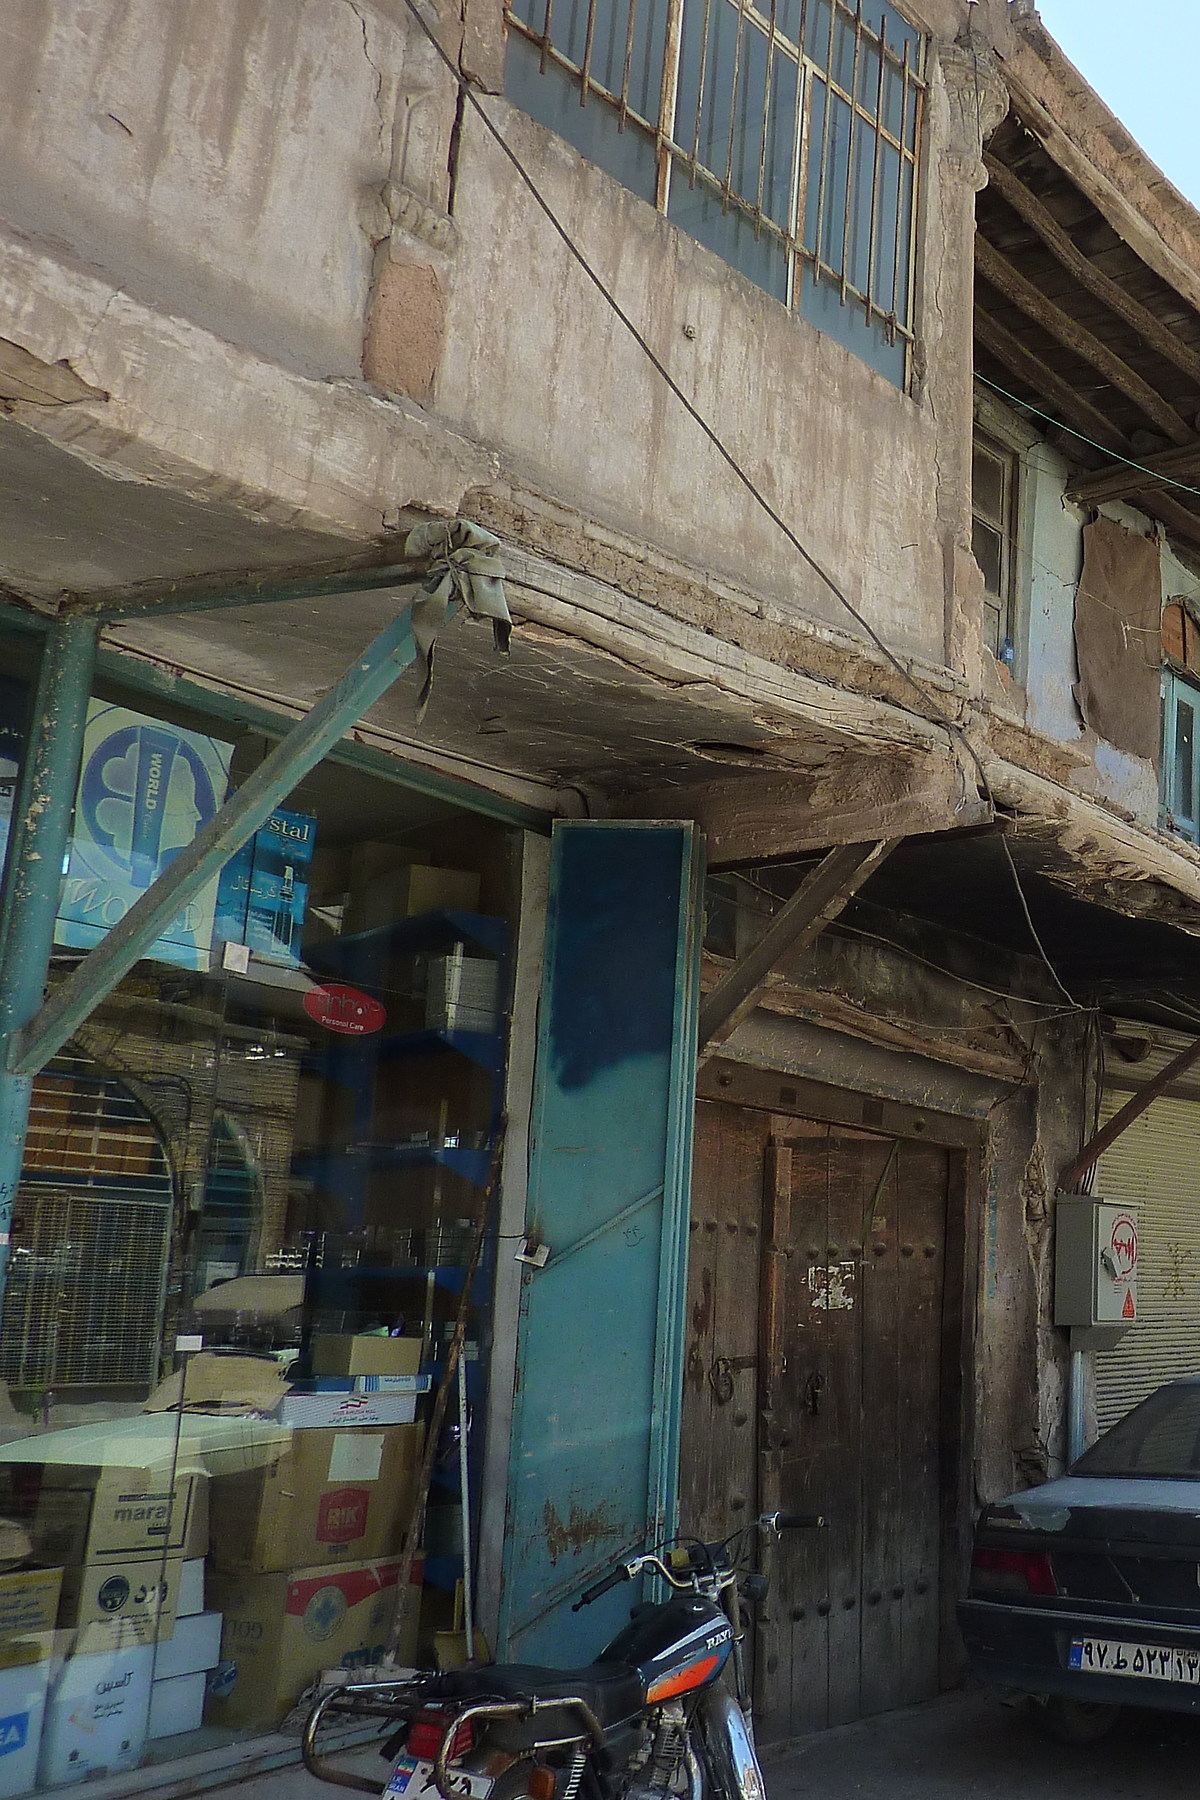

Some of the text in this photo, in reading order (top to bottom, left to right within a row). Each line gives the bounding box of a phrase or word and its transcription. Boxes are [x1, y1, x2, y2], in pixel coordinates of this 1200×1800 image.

[145, 752, 163, 811] WORLD
[265, 817, 310, 841] stal
[67, 878, 203, 933] WOD
[321, 1015, 364, 1032] Personal Care
[1084, 1641, 1108, 1667] ۹۷
[1132, 1647, 1171, 1676] ۵۲۳
[1176, 1657, 1199, 1680] ۱۳
[388, 1781, 406, 1793] IRAN
